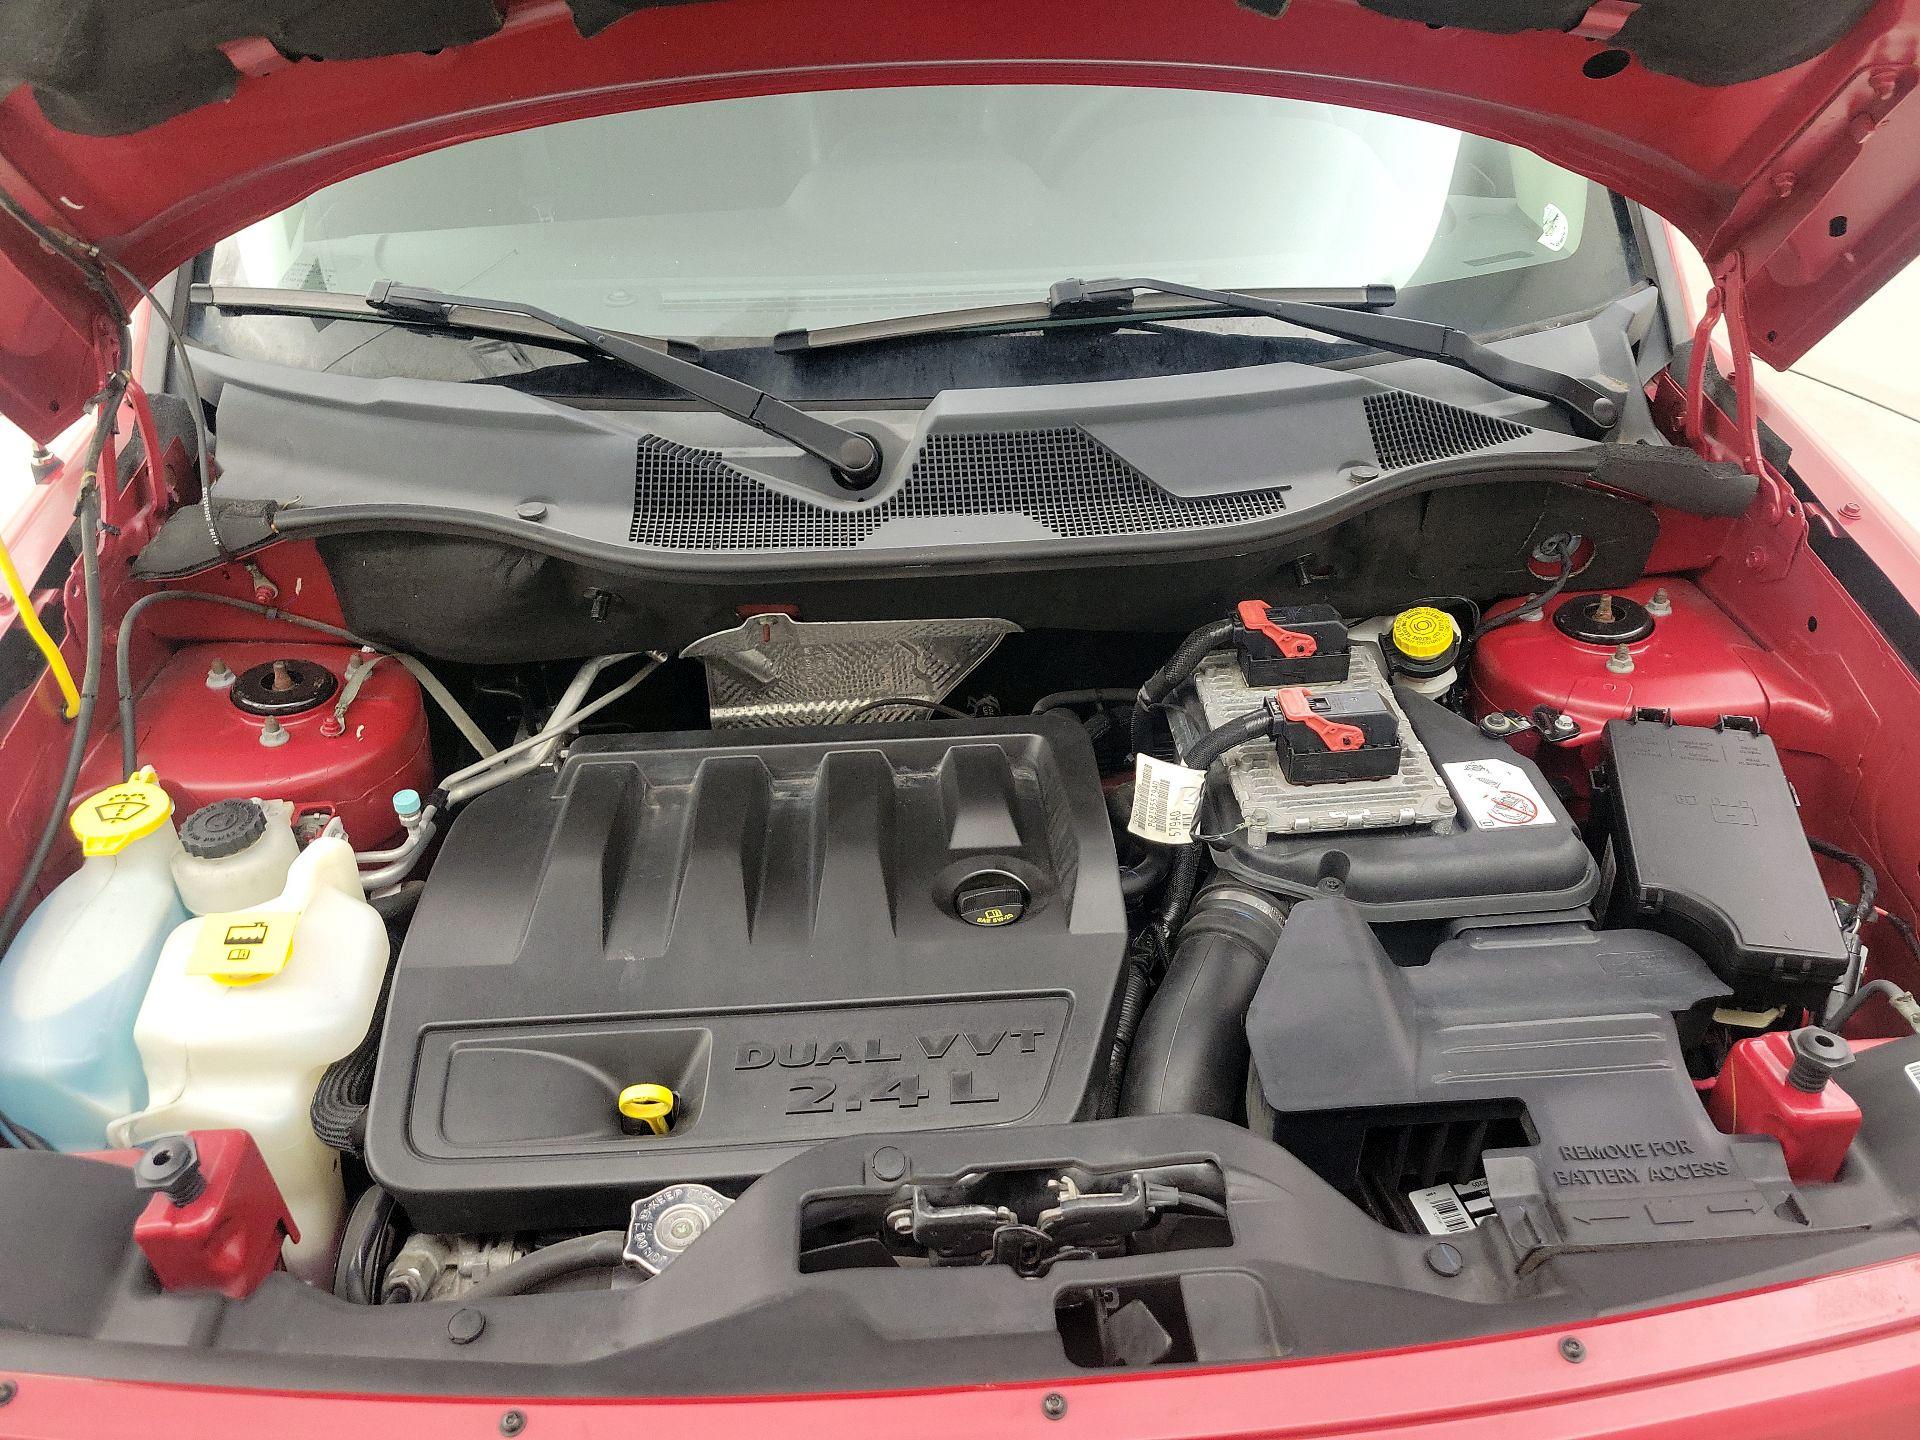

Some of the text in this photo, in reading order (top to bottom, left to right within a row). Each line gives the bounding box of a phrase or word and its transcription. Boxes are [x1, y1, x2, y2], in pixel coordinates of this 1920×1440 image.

[735, 1028, 1045, 1071] DUAL VVT
[785, 1070, 999, 1115] 2.4L
[1559, 1139, 1695, 1161] REMOVE FOR
[1553, 1161, 1730, 1186] BATTERY ACCESS
[648, 1189, 683, 1210] KEEP
[634, 1222, 653, 1231] TVS
